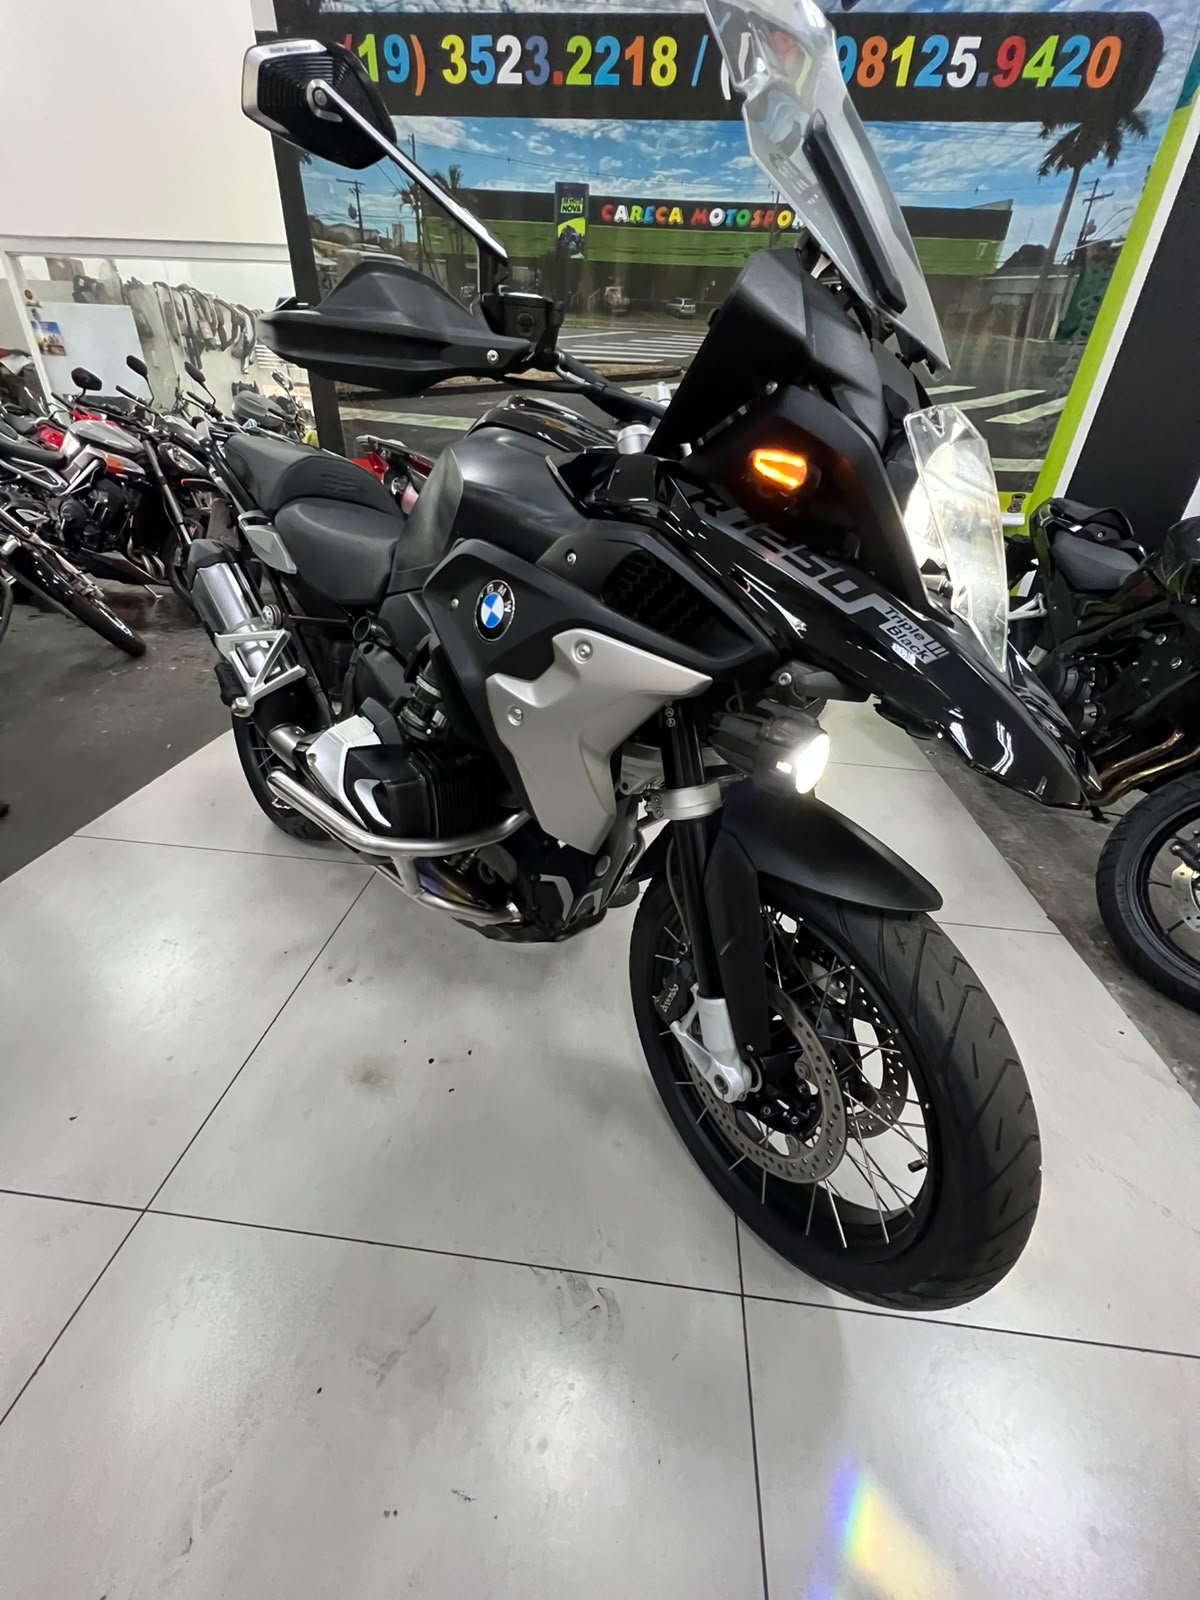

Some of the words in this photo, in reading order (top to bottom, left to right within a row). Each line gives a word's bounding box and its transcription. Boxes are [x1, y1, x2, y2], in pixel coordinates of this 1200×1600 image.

[441, 34, 677, 87] 3523.2218
[601, 204, 683, 225] CARECA
[486, 583, 512, 613] BMW
[885, 606, 925, 641] Triple
[886, 625, 930, 660] Black
